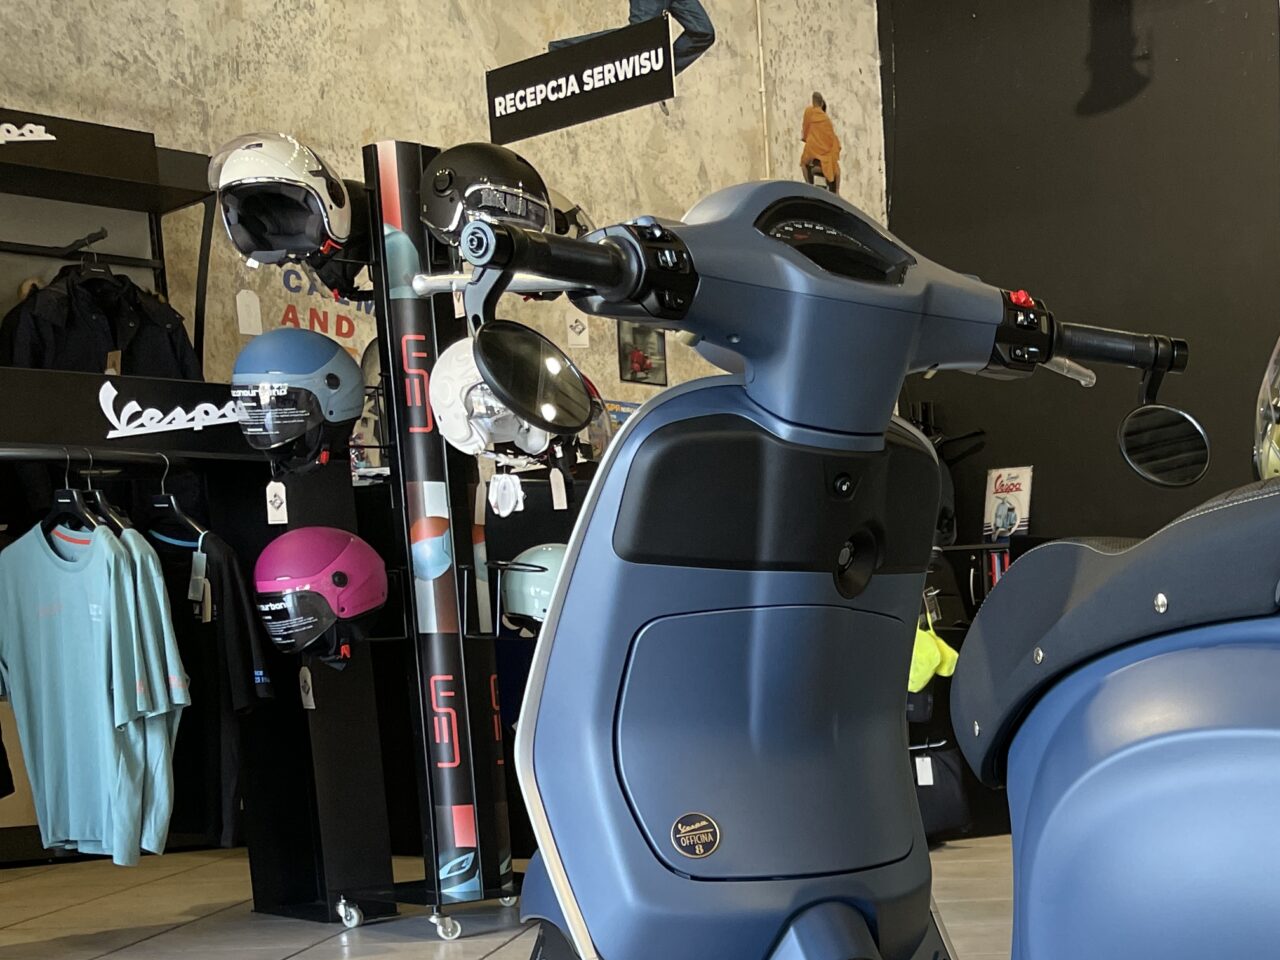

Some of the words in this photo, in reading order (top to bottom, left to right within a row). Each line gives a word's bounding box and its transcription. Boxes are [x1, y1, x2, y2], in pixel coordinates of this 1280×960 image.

[494, 74, 580, 117] RECEPCJA
[582, 48, 664, 91] SERWISU
[281, 304, 355, 338] AND
[681, 832, 714, 847] OFFICINA
[695, 844, 704, 855] 8
